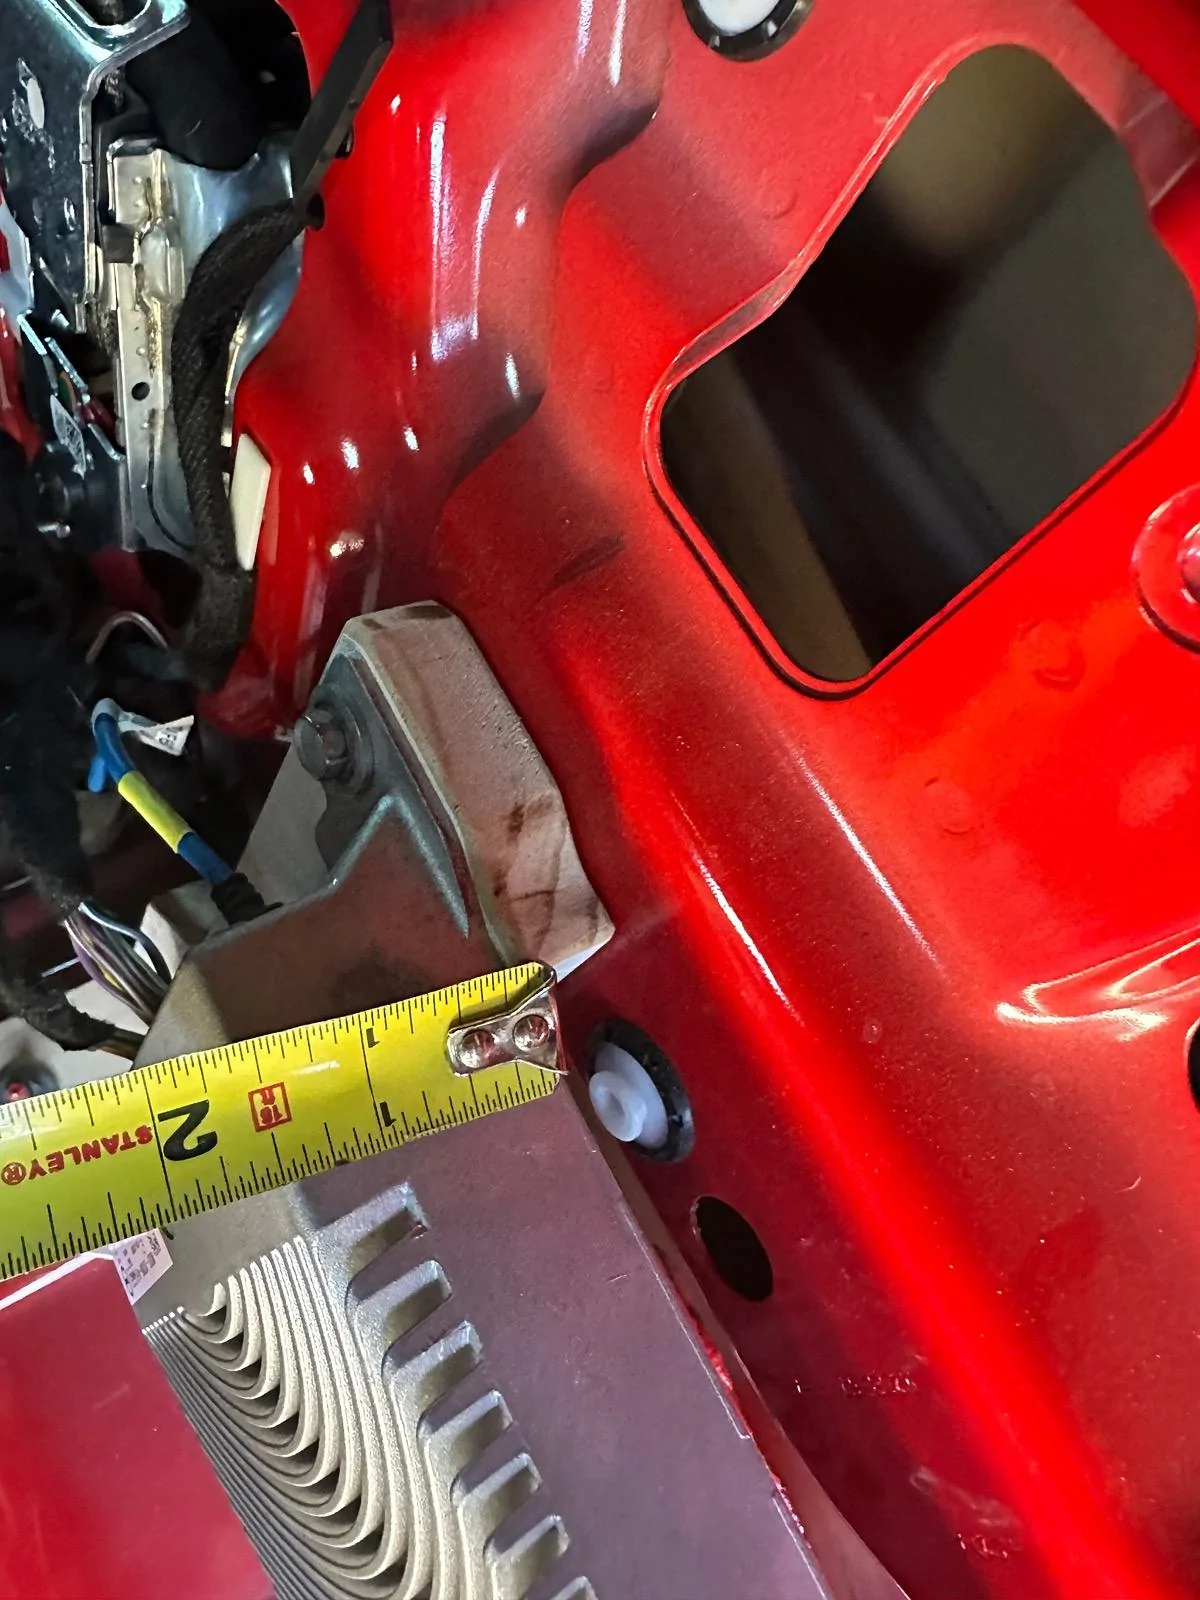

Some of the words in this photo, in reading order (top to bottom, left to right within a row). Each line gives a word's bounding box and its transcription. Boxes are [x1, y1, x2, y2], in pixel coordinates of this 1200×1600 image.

[366, 1027, 380, 1048] 1
[379, 1101, 397, 1128] 1
[158, 1099, 218, 1162] 2
